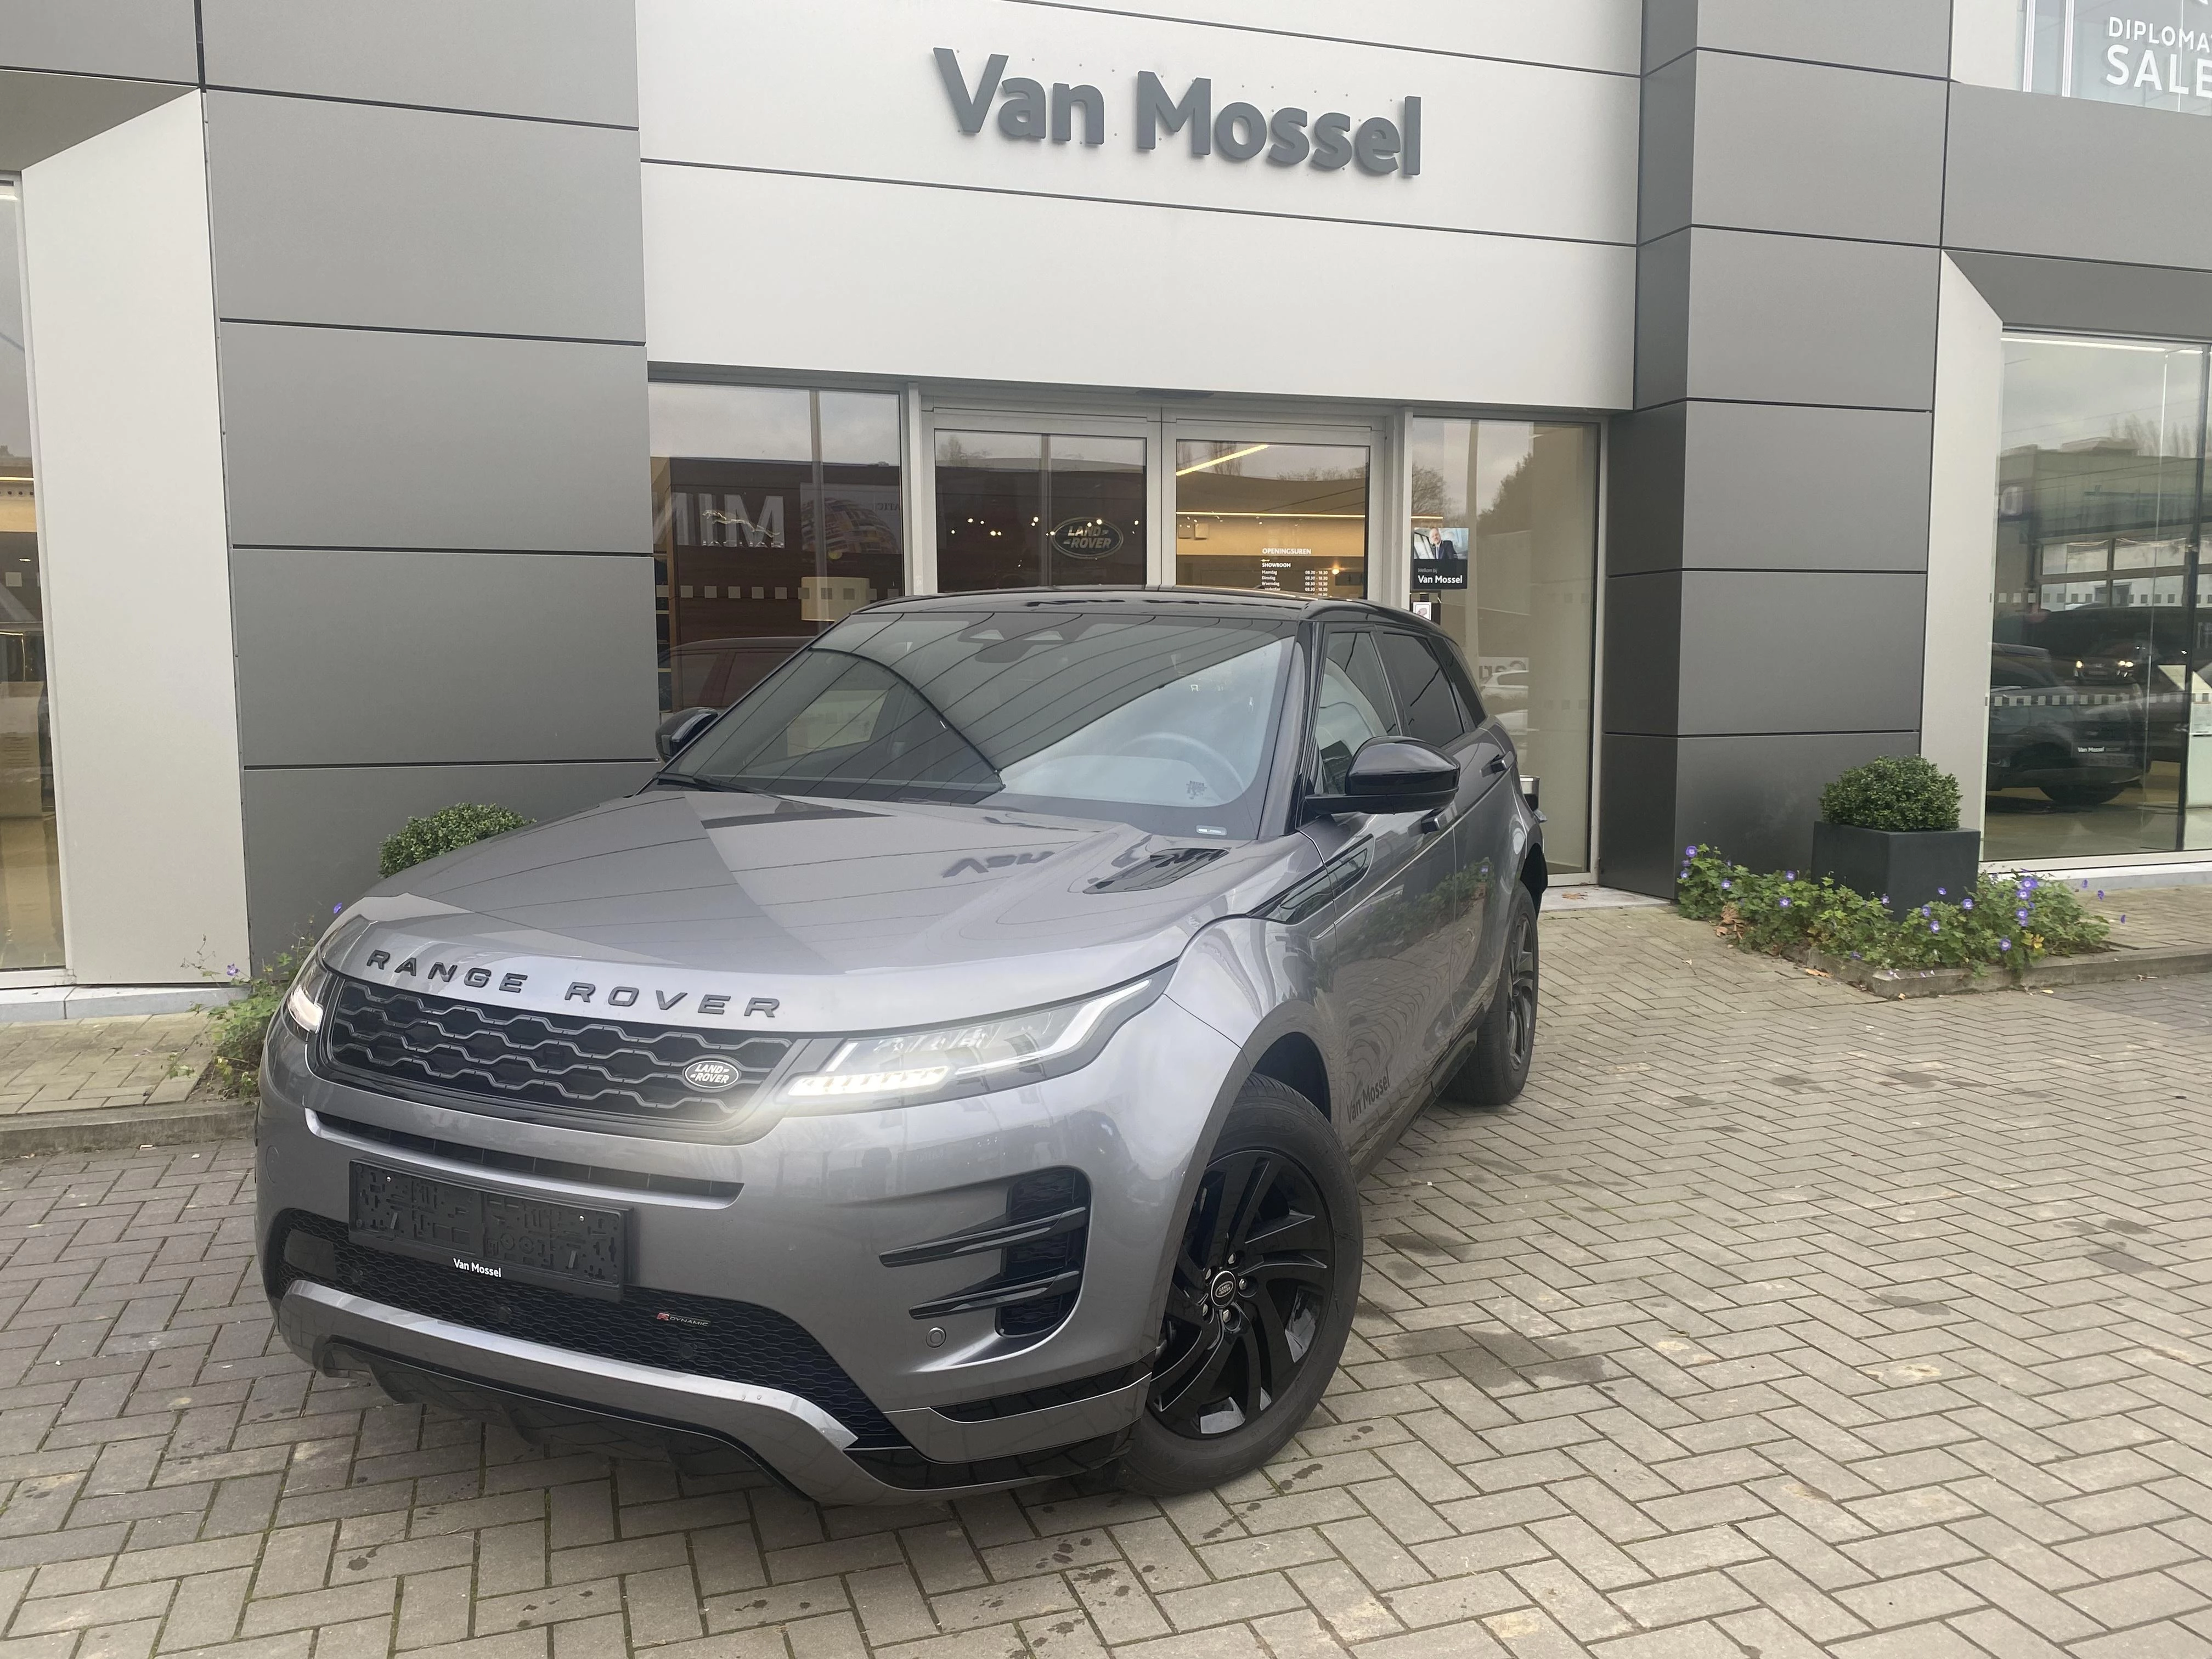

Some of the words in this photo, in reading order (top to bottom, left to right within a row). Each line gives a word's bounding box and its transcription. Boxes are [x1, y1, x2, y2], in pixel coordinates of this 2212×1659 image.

[2108, 16, 2212, 53] DIPLOMA
[933, 47, 1104, 144] Van
[1137, 70, 1421, 176] Mossel
[1068, 526, 1101, 537] LAND
[1070, 538, 1111, 549] ROVER
[1418, 575, 1433, 583] Van
[1435, 575, 1463, 583] Mossel
[366, 949, 528, 993] RANGE
[565, 981, 780, 1018] ROVER
[695, 1064, 724, 1074] LAND
[695, 1073, 730, 1084] ROVER
[1346, 1099, 1362, 1124] Van
[1362, 1066, 1390, 1109] Mossel
[453, 1258, 470, 1271] Van
[471, 1262, 501, 1278] Mossel
